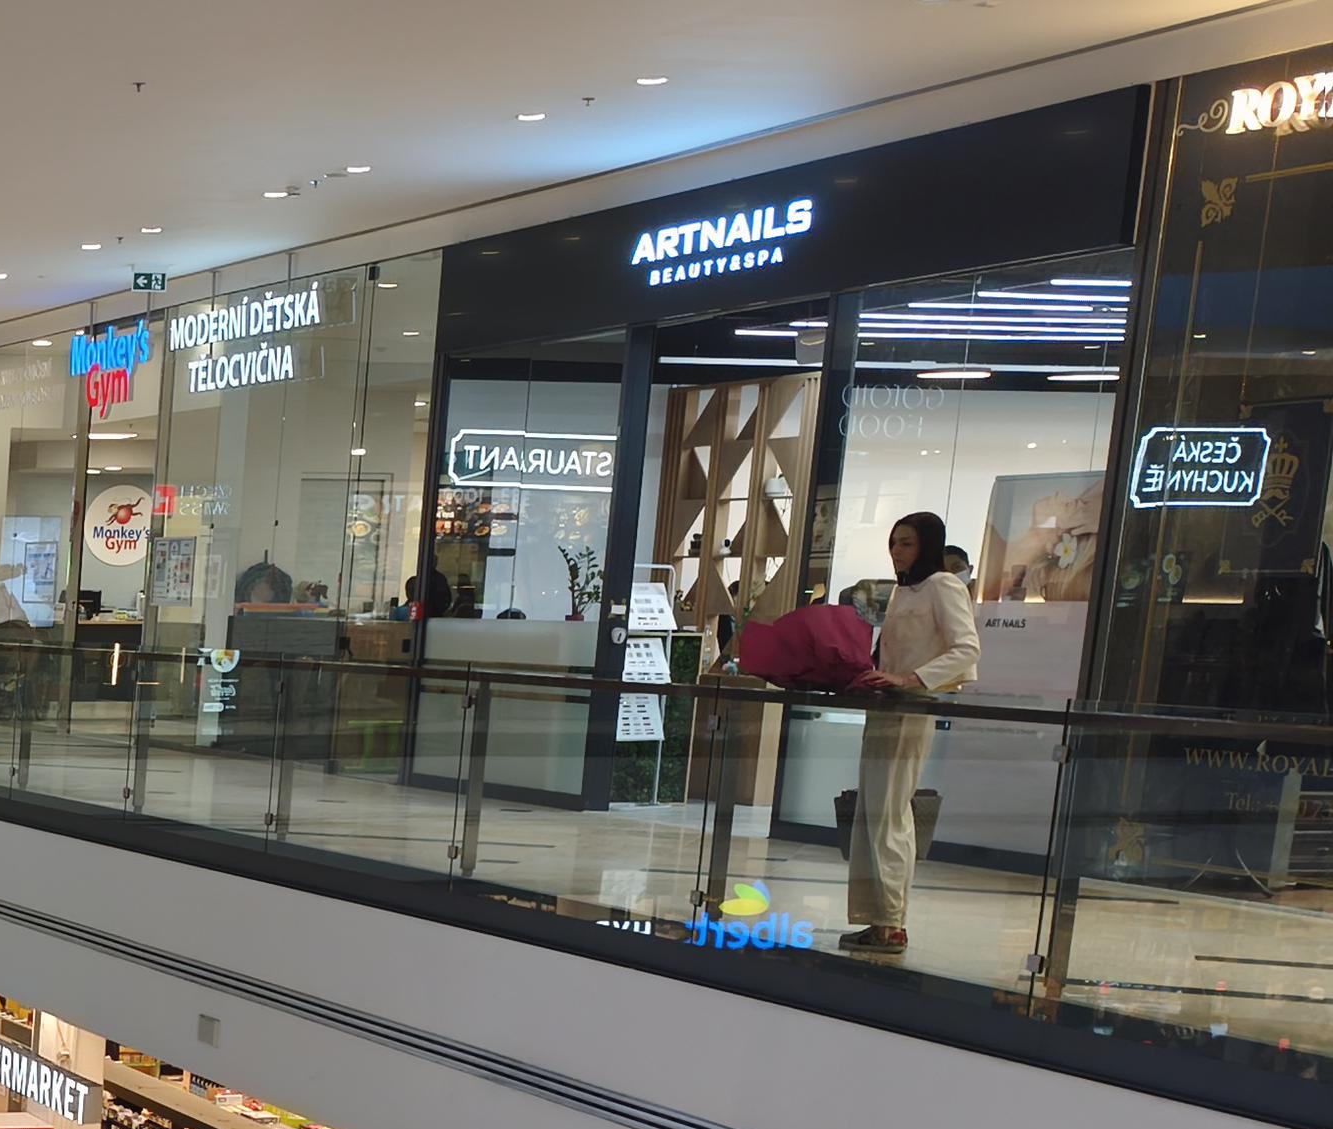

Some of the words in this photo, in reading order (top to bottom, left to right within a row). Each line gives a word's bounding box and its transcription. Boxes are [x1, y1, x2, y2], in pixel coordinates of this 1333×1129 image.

[631, 198, 813, 267] ARTNAILS
[648, 248, 784, 287] BEAUTY&SPA
[170, 296, 248, 351] MODERNÍ
[249, 281, 320, 336] DĚTSKÁ
[70, 319, 150, 377] Monkey's
[188, 341, 294, 393] TĚLOCVIČNA
[86, 364, 129, 420] Gym
[93, 525, 151, 542] Monkey's
[104, 537, 138, 554] Gym
